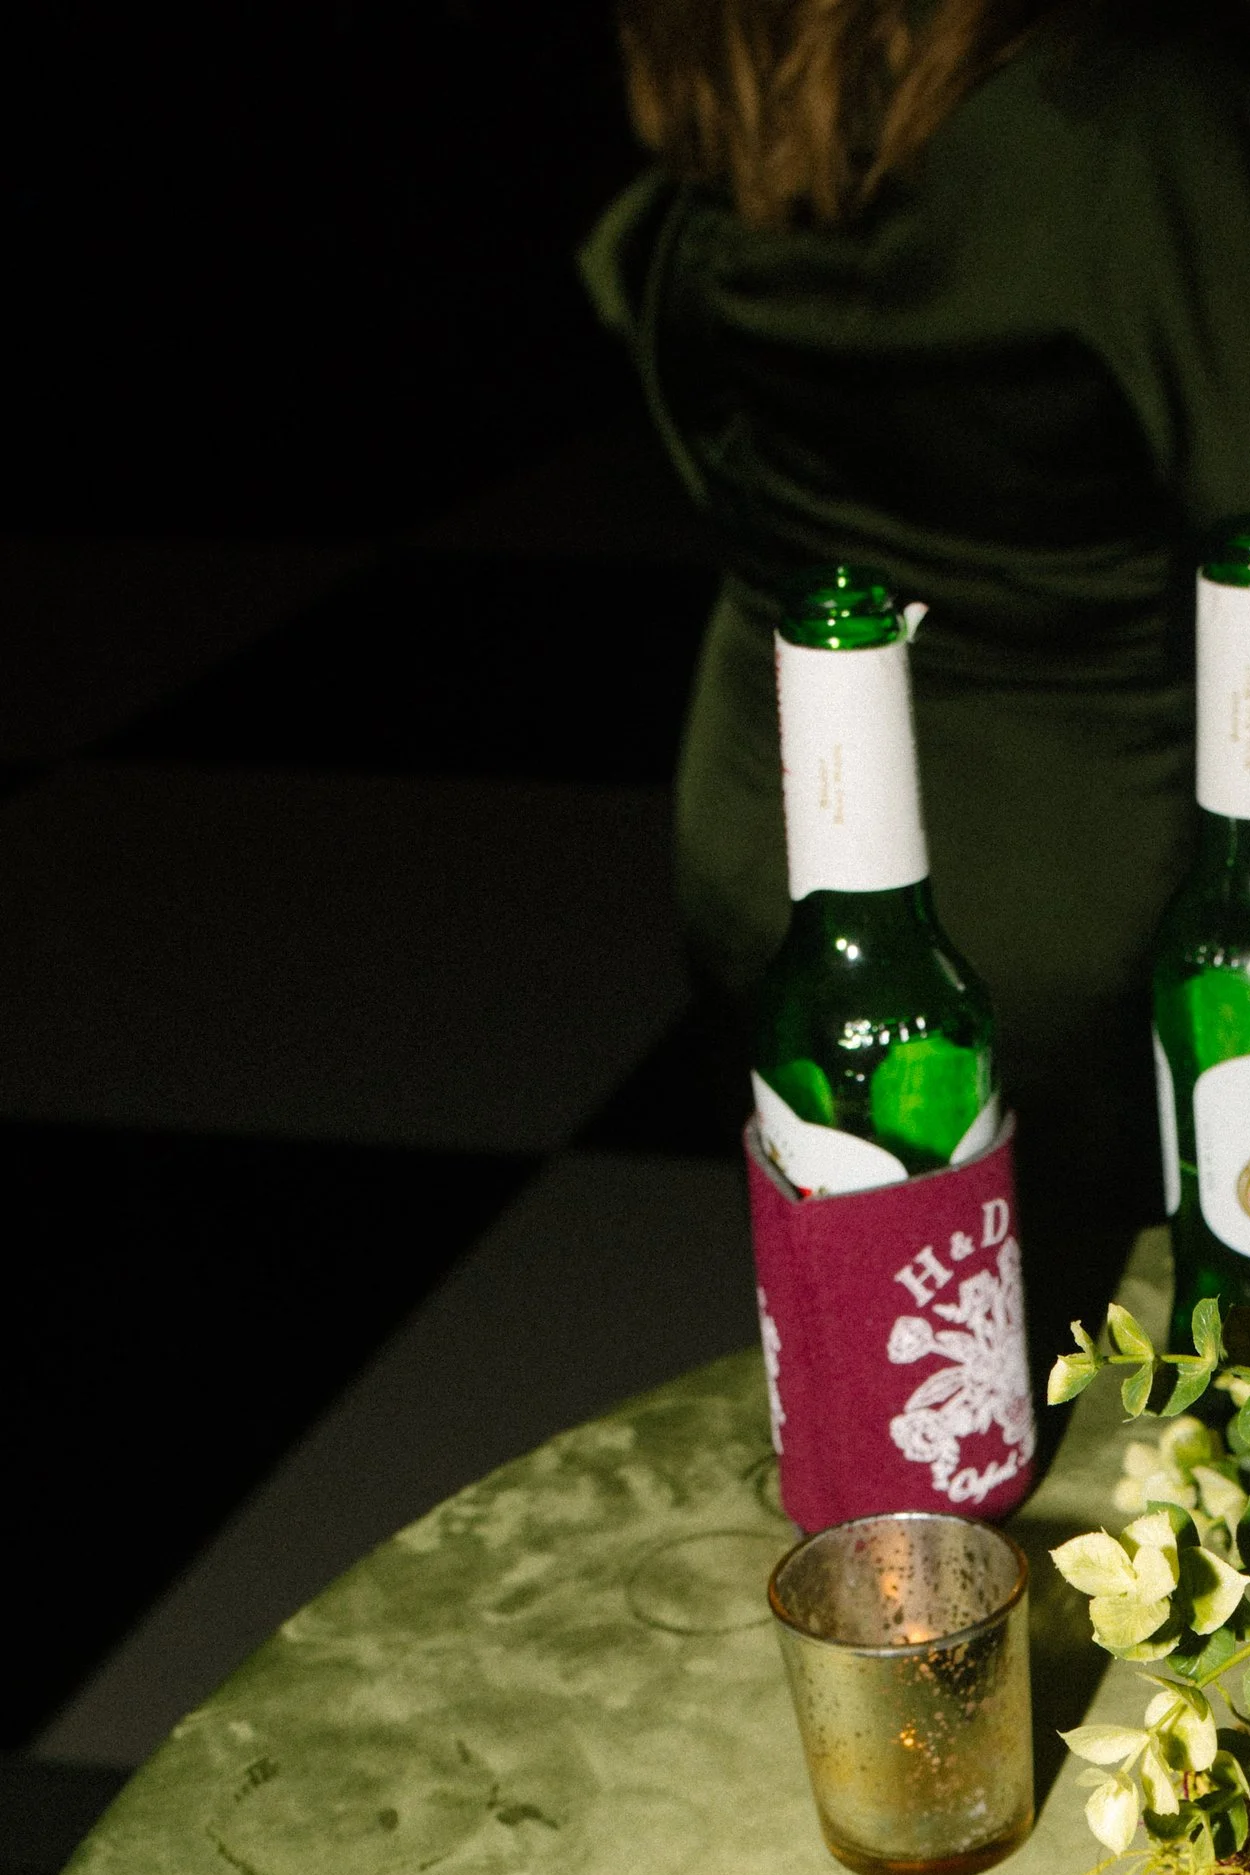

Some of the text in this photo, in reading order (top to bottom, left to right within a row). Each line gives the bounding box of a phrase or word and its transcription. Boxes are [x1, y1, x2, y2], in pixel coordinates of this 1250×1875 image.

[894, 1198, 1010, 1308] H & D
